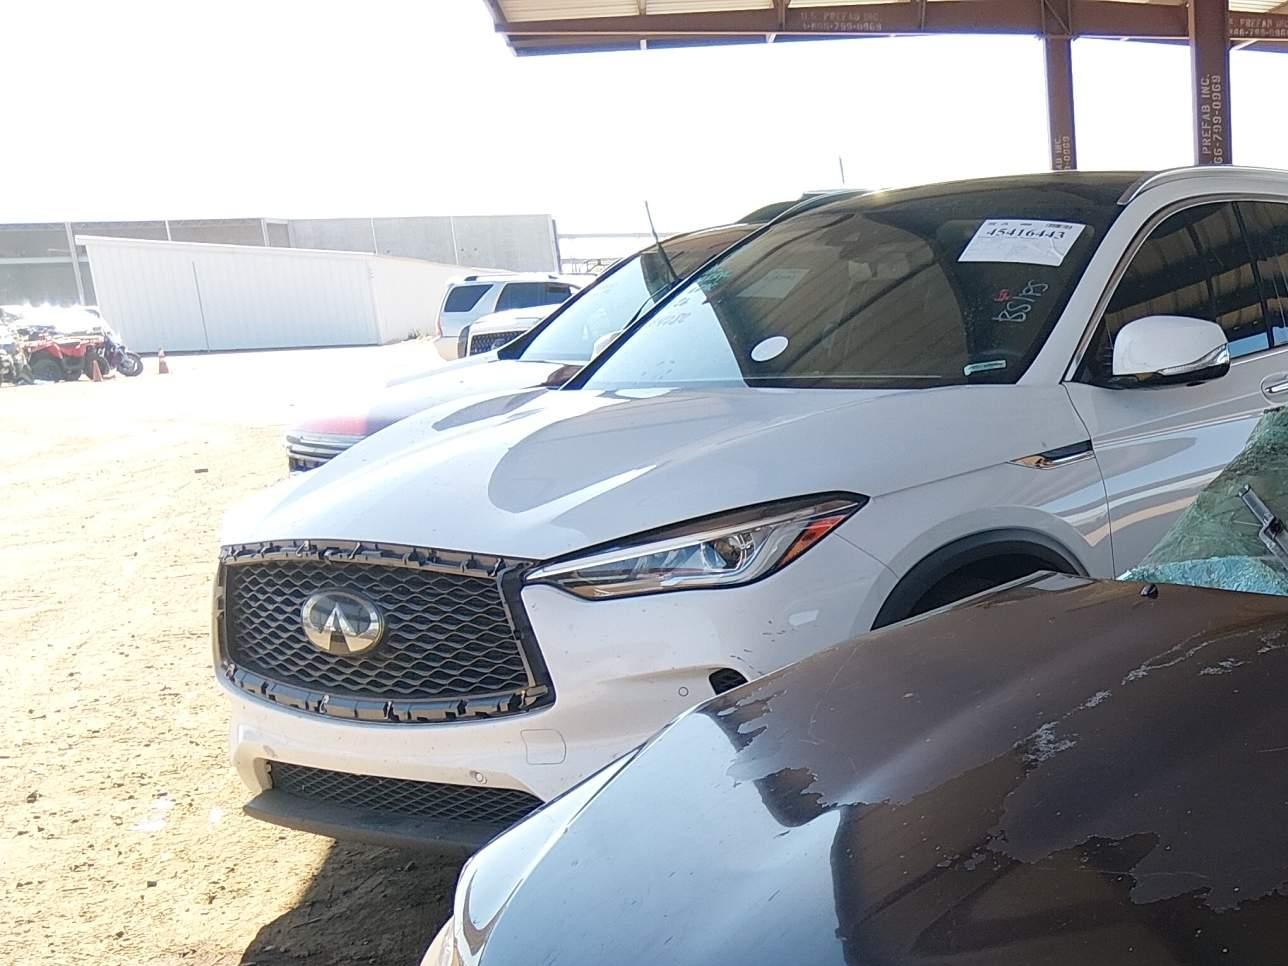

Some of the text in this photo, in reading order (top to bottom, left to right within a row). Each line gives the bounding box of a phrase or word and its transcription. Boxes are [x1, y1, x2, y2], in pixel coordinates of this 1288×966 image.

[1200, 73, 1212, 155] PREFAB INC.
[985, 228, 1066, 240] 45416443
